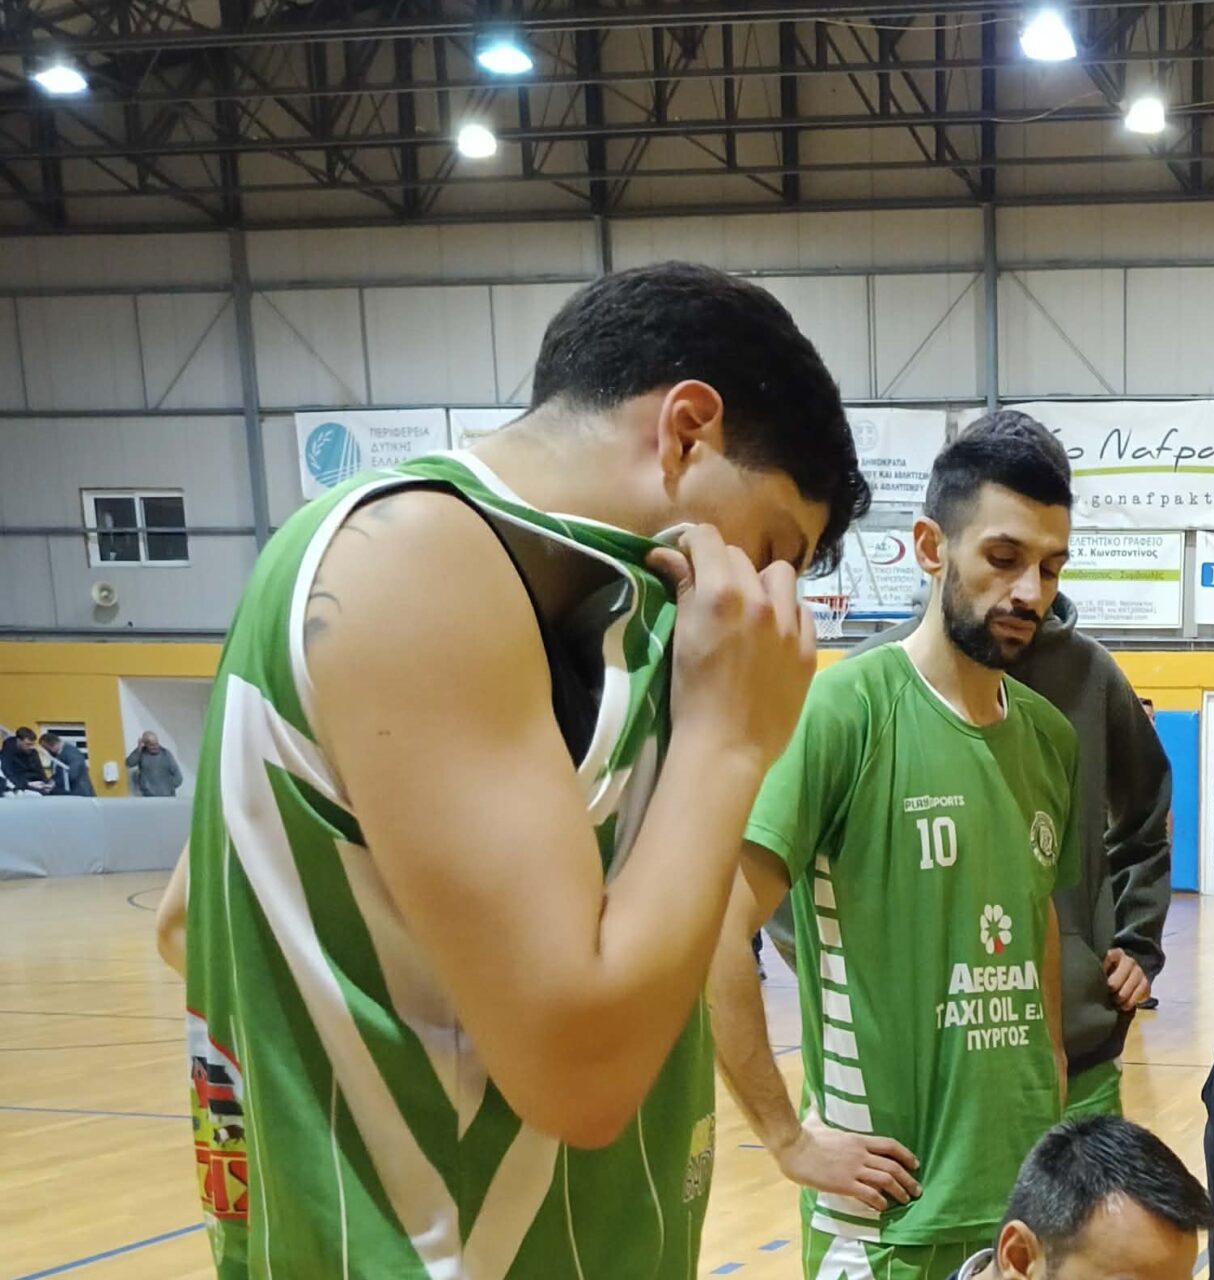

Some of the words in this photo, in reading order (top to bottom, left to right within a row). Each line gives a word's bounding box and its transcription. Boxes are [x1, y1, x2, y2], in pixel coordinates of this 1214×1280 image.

[369, 427, 430, 438] ΠΕΡΙΦΕΡΕΙΑ
[371, 443, 412, 452] ΔΥΤΙΚΗΣ
[371, 457, 407, 466] ΕΛΛΑ
[1123, 536, 1163, 546] ΓΡΑΦΕΙΟ
[916, 816, 957, 870] 10
[936, 998, 984, 1028] TAXI
[989, 996, 1019, 1023] OIL
[967, 1025, 1030, 1050] ΠΥΡΓΟΣ
